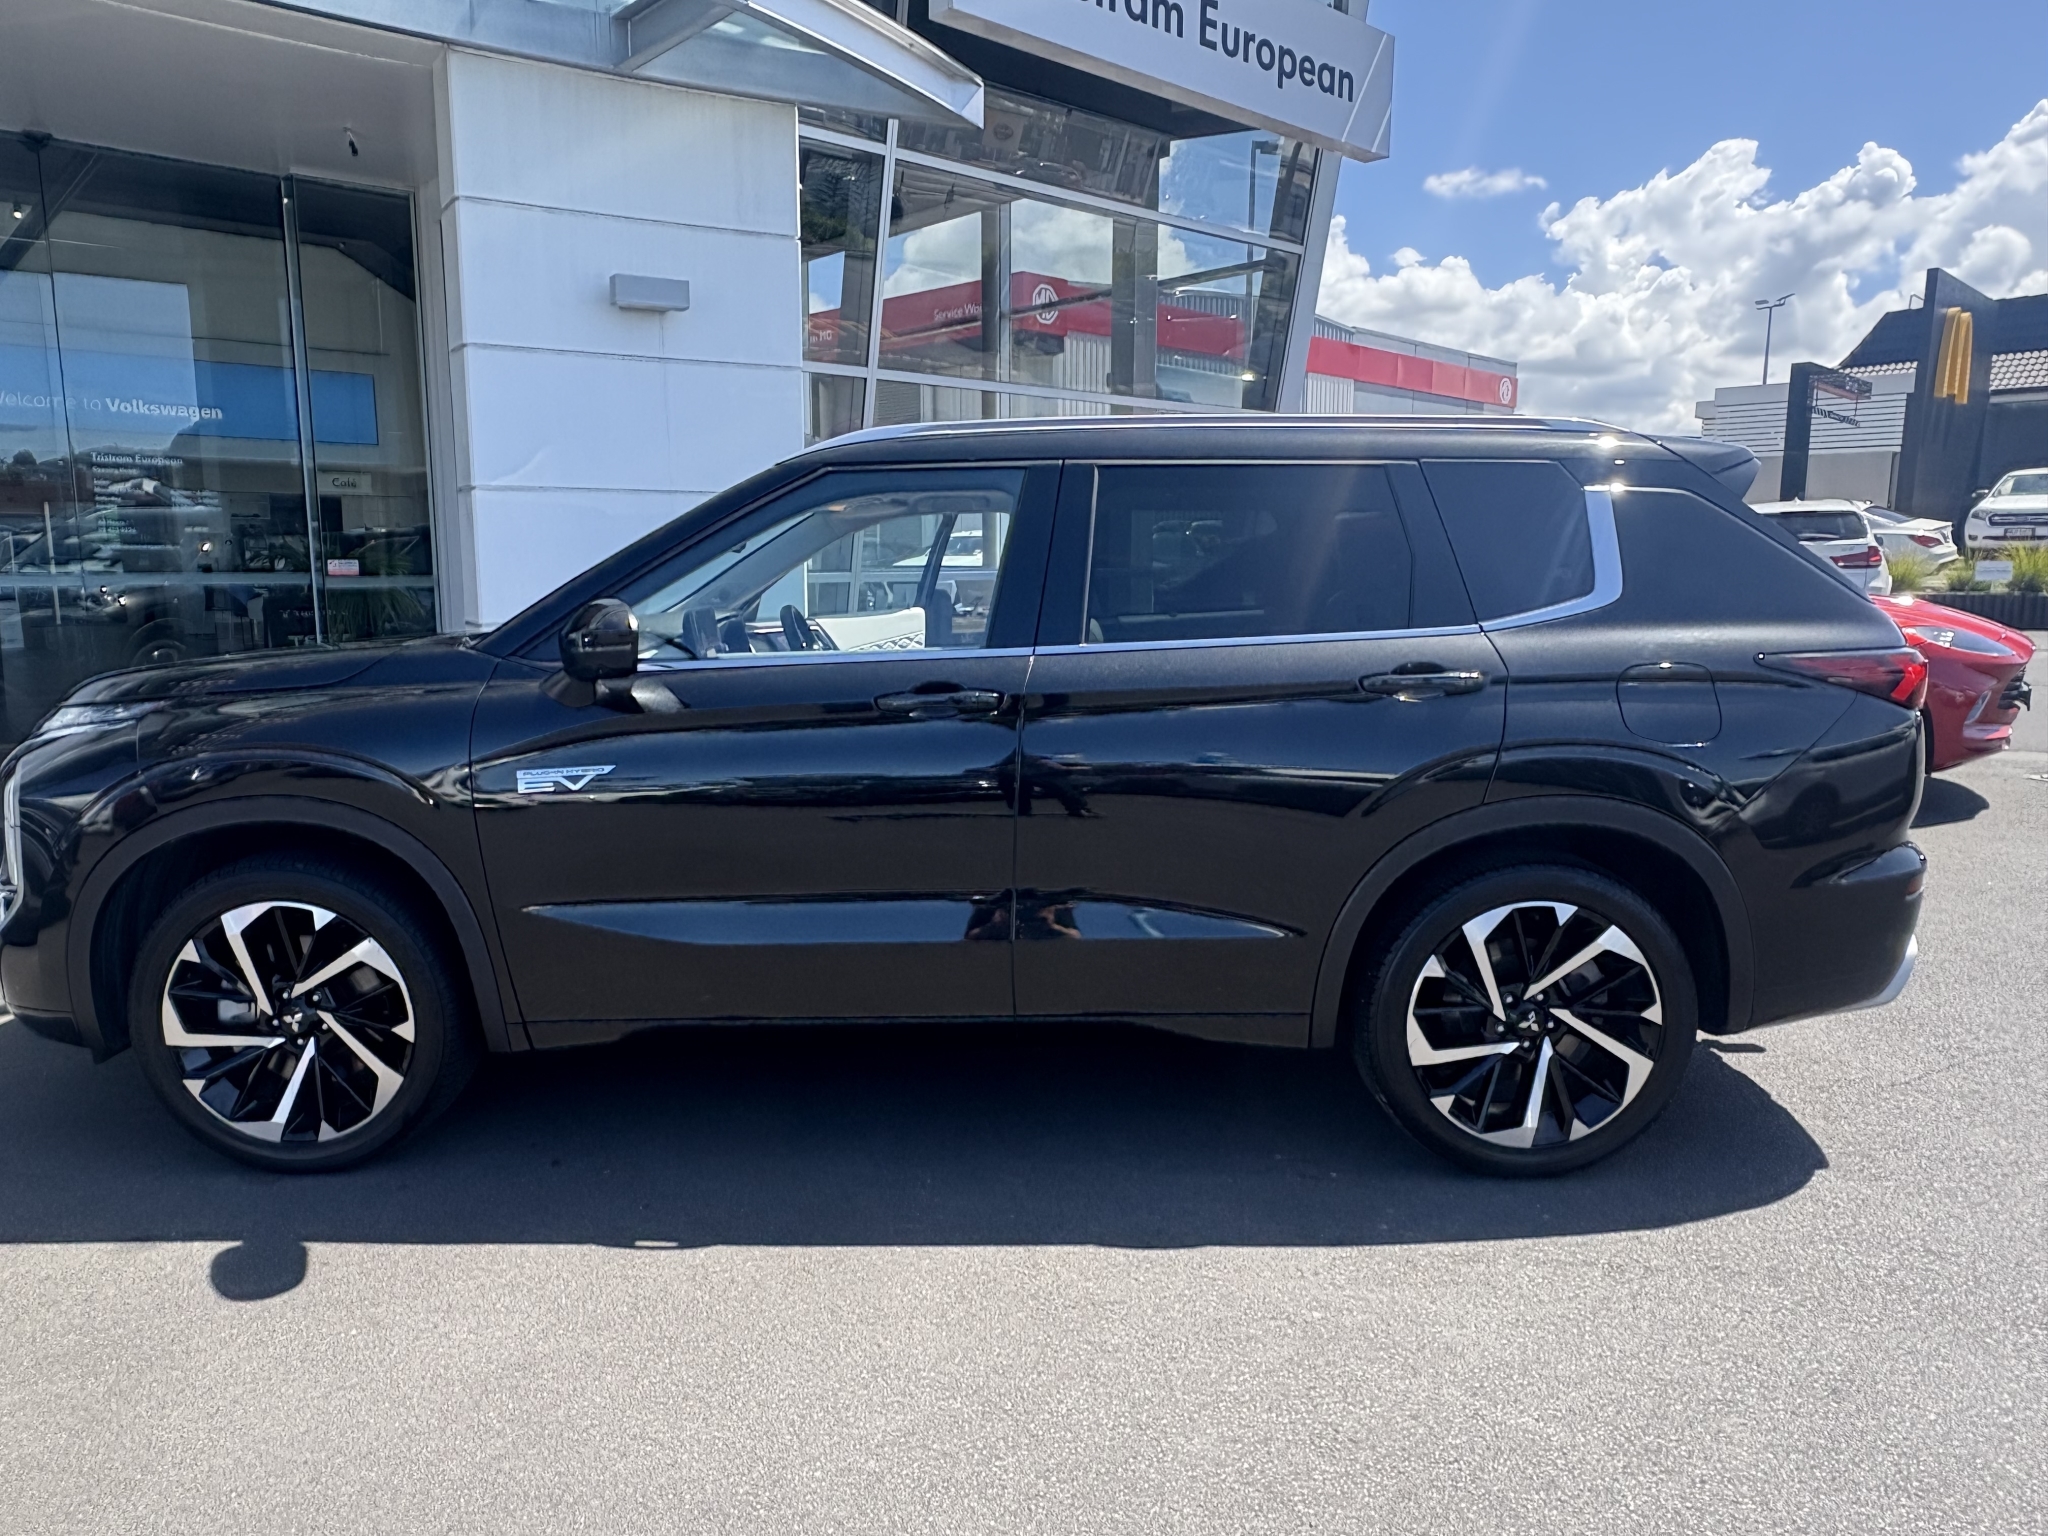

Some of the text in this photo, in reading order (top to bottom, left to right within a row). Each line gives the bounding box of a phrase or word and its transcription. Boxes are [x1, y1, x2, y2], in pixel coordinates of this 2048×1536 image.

[1200, 0, 1354, 103] European
[933, 307, 963, 321] Service
[1034, 286, 1058, 322] MG
[0, 390, 223, 421] elcome to Volkswagen
[91, 451, 184, 466] Tristram European
[518, 776, 598, 794] EV
